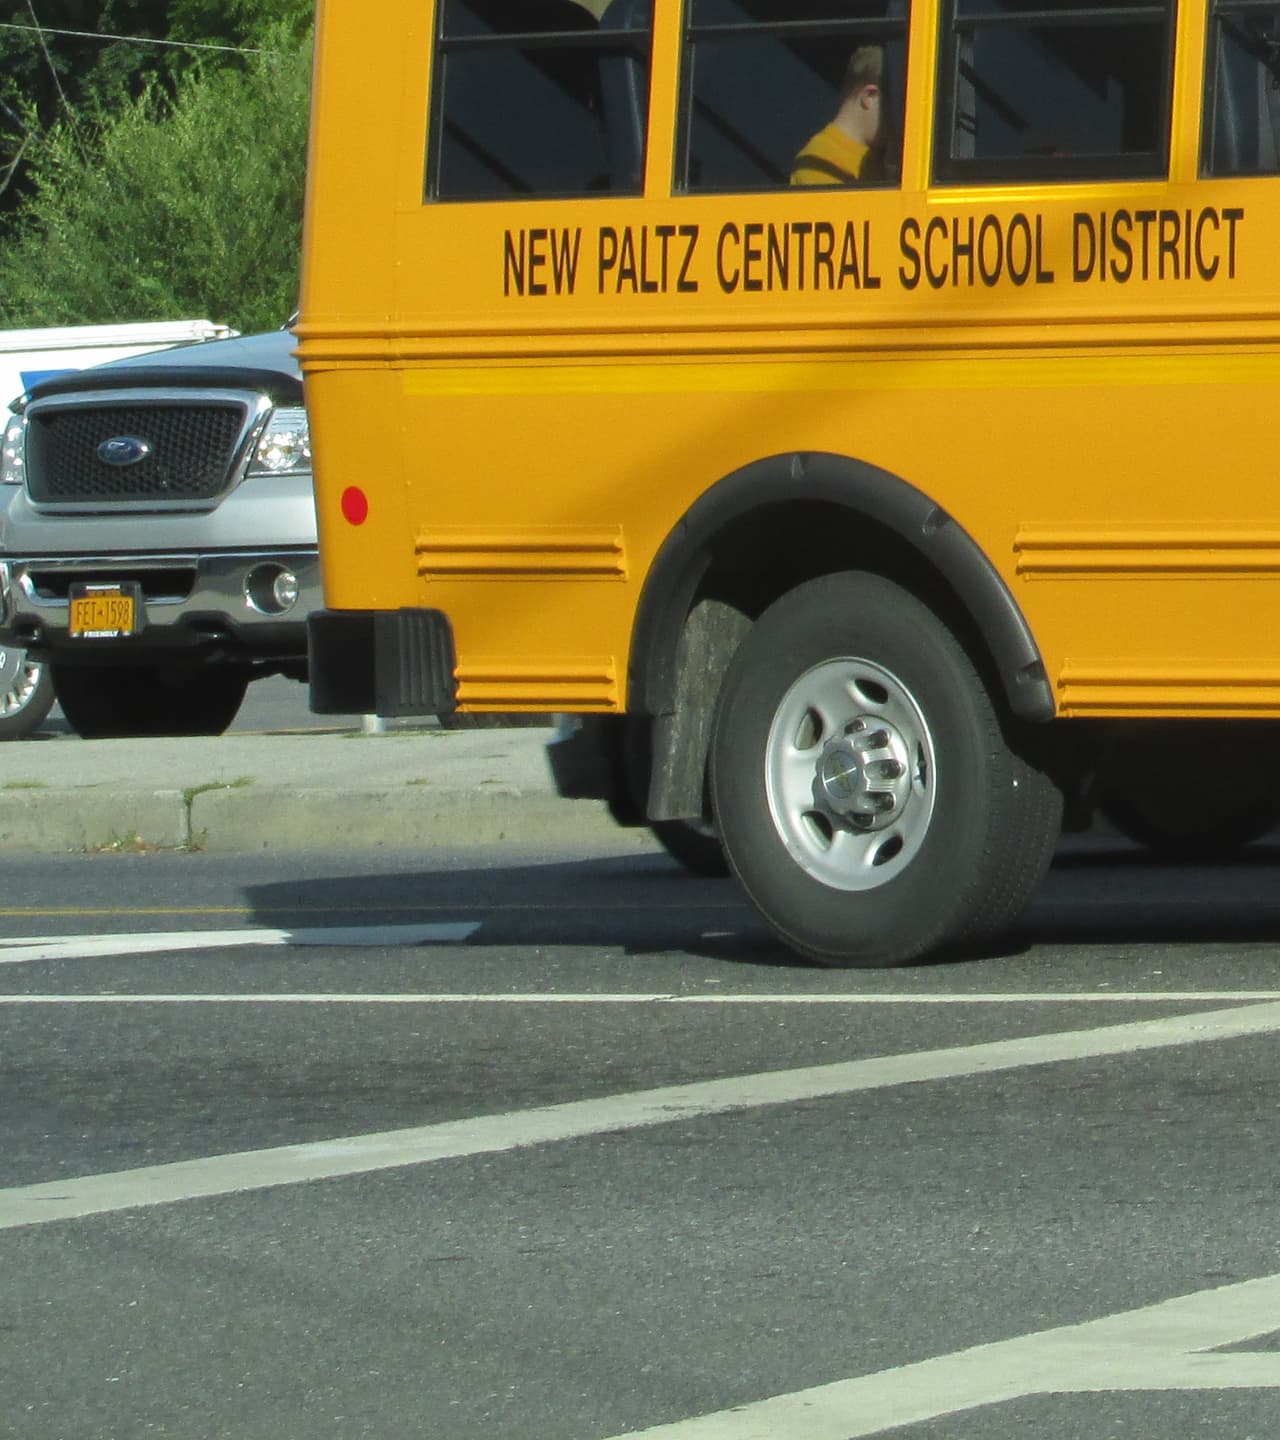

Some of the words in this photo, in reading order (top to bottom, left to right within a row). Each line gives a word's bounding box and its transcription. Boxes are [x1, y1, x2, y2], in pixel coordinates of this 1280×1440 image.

[503, 228, 581, 297] NEW
[599, 225, 699, 294] PALTZ
[717, 221, 881, 294] CENTRAL
[899, 213, 1054, 290] SCHOOL
[1073, 208, 1244, 284] DISTRICT
